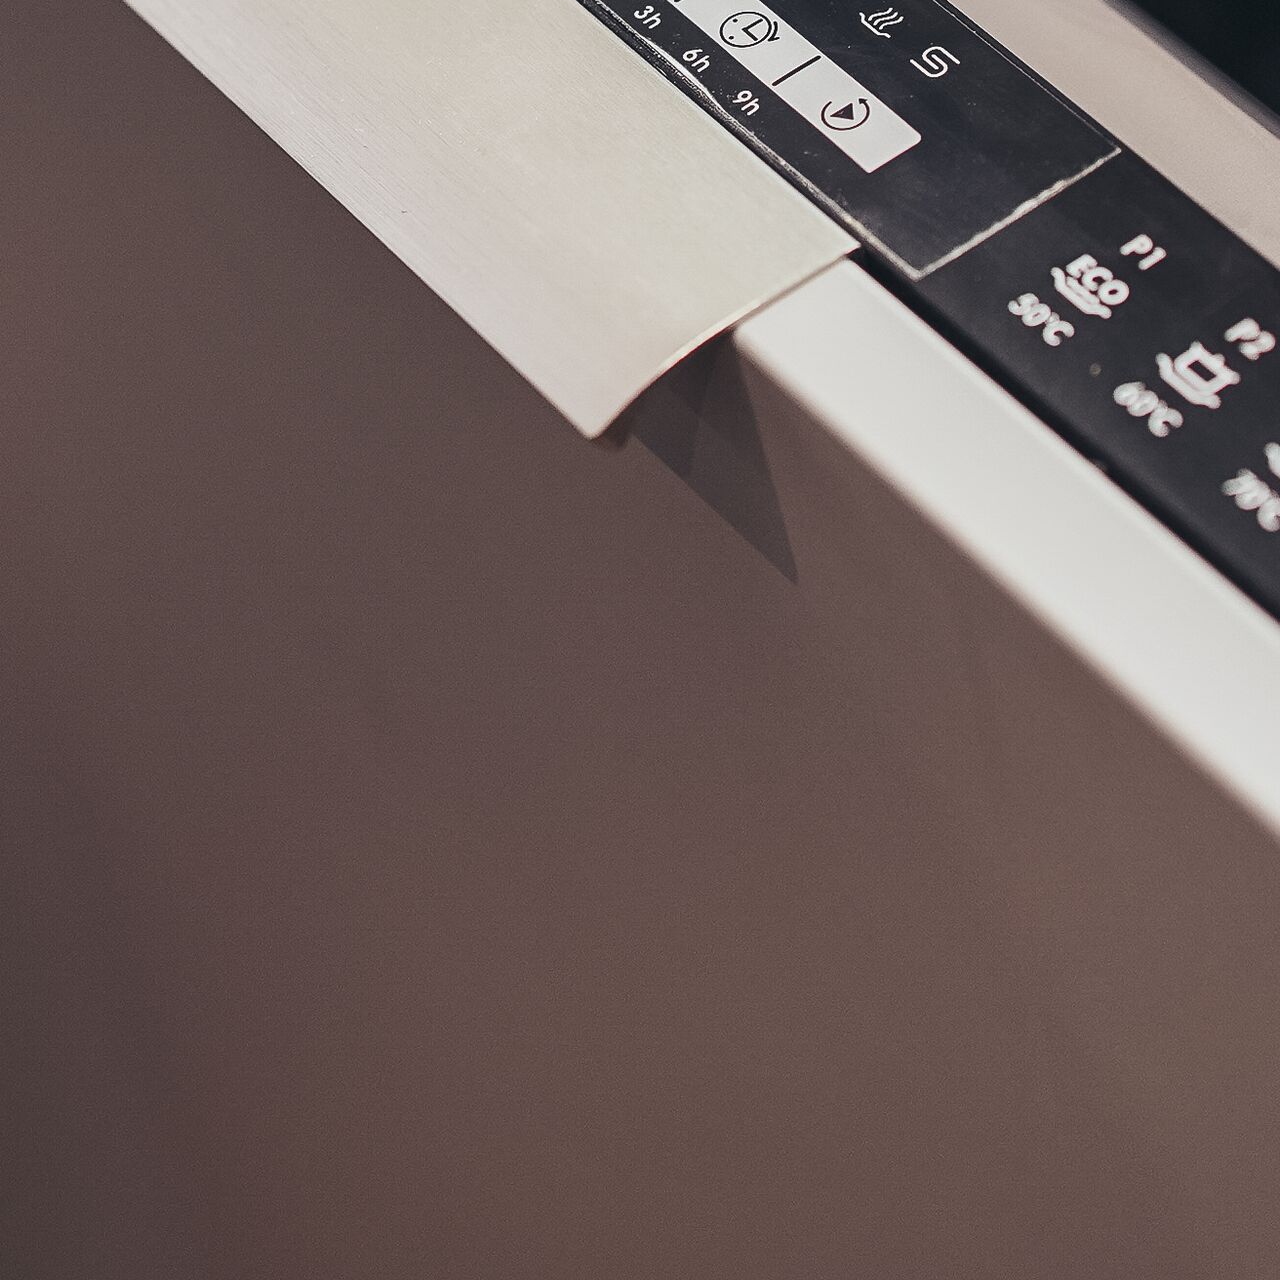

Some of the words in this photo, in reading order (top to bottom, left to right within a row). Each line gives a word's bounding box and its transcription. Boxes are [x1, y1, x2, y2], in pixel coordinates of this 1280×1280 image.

[633, 5, 662, 30] 3h
[682, 48, 710, 73] 6h
[732, 90, 760, 116] 9h
[1007, 292, 1075, 347] 50°C
[1065, 253, 1130, 306] ECO
[1119, 234, 1167, 271] P1
[1224, 318, 1276, 361] P2
